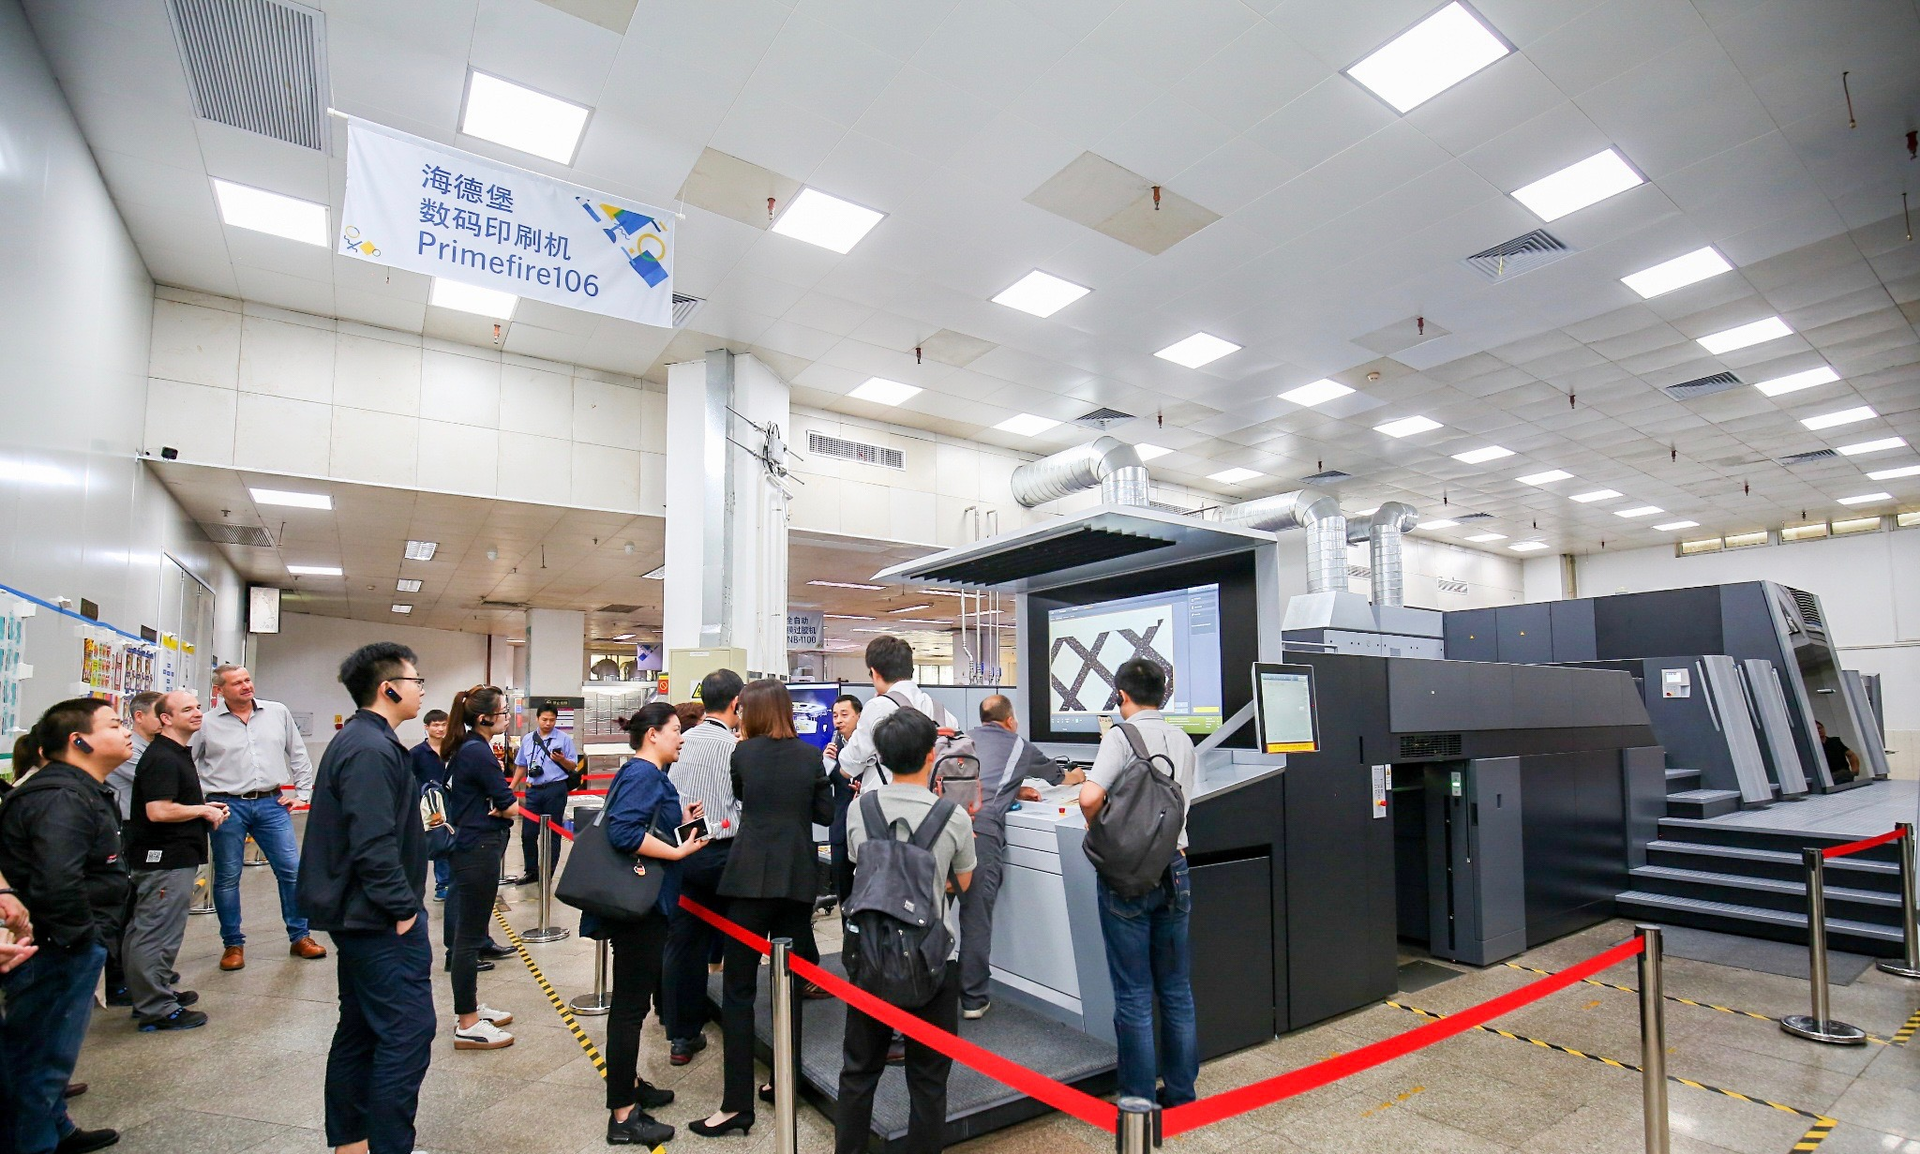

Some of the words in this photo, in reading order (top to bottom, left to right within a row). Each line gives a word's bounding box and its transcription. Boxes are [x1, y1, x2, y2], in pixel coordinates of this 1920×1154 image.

[421, 163, 514, 213] 海德堡
[419, 197, 571, 261] 数码印刷机
[418, 230, 599, 297] Primefire106
